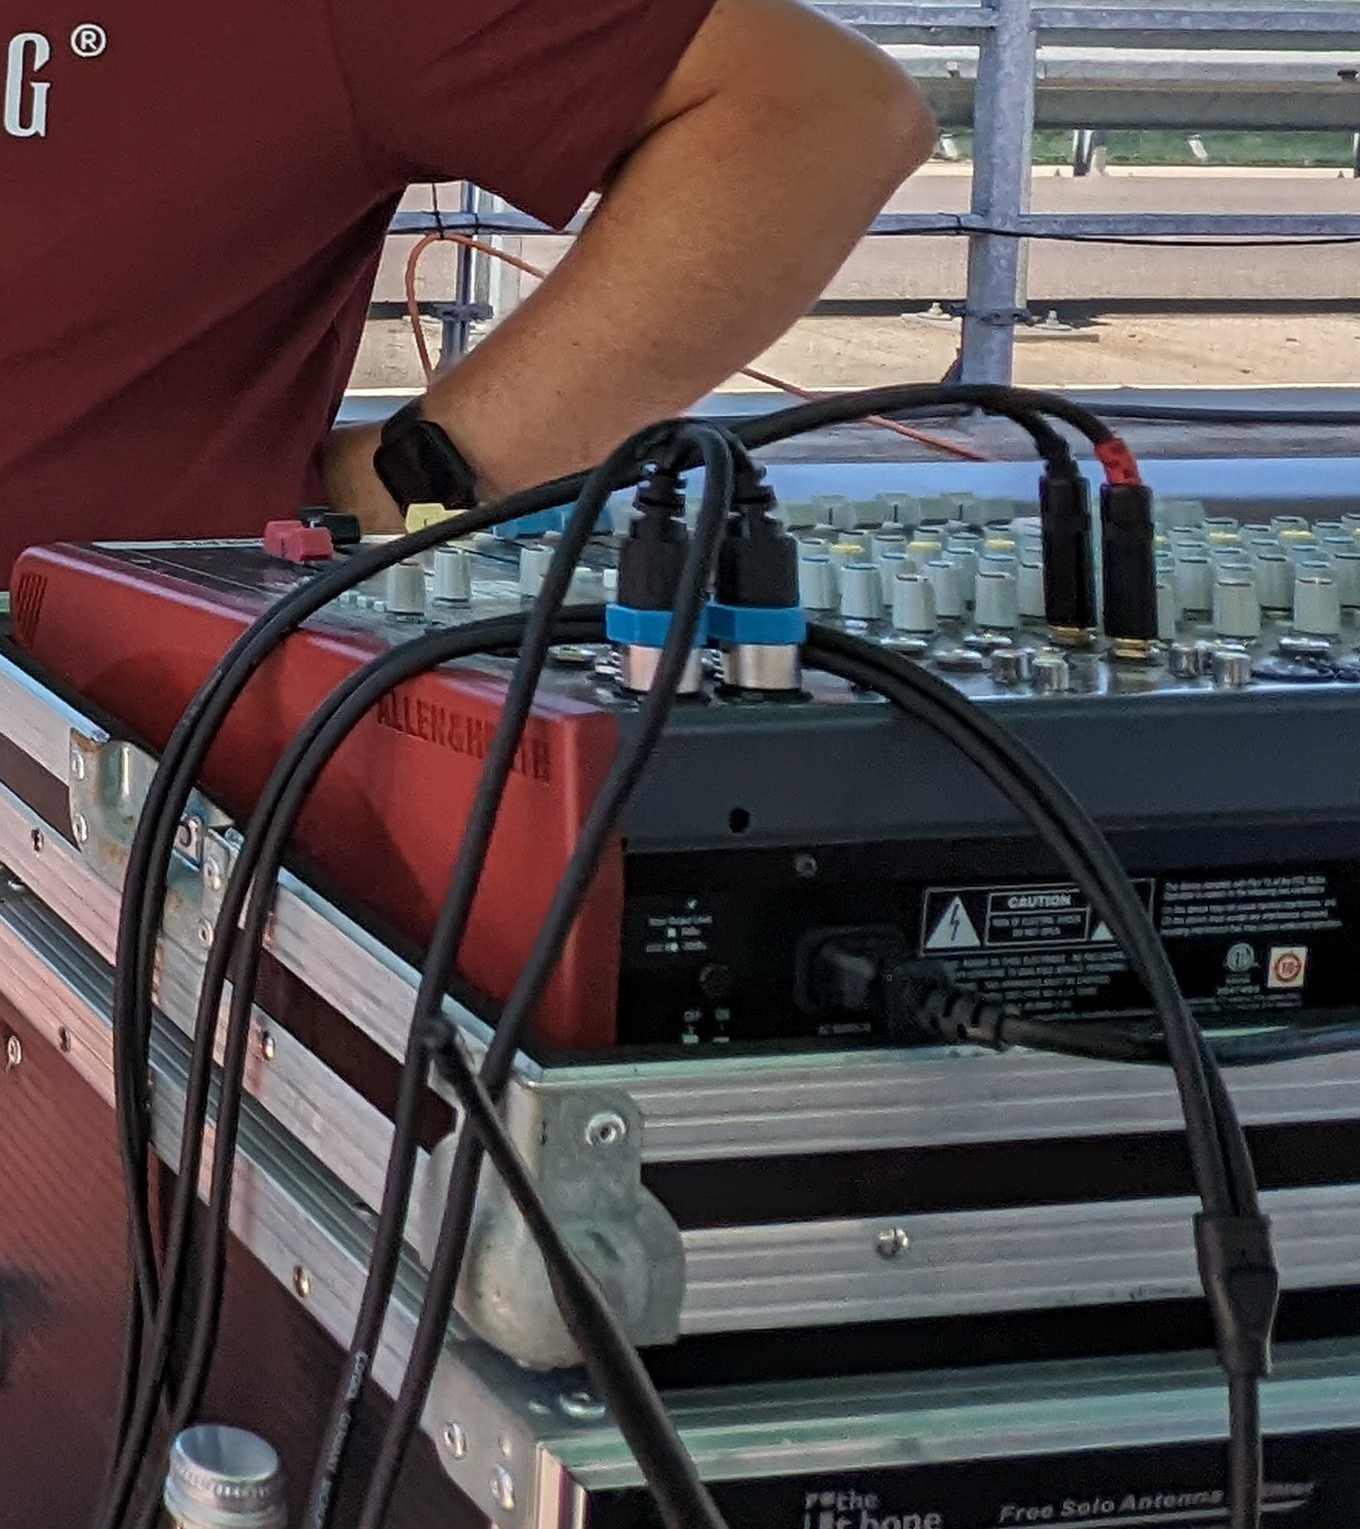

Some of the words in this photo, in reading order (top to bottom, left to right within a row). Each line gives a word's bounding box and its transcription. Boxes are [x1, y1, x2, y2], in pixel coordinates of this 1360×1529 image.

[1008, 895, 1072, 909] CAUTION
[1000, 1504, 1054, 1524] Free
[1060, 1496, 1116, 1518] Solo
